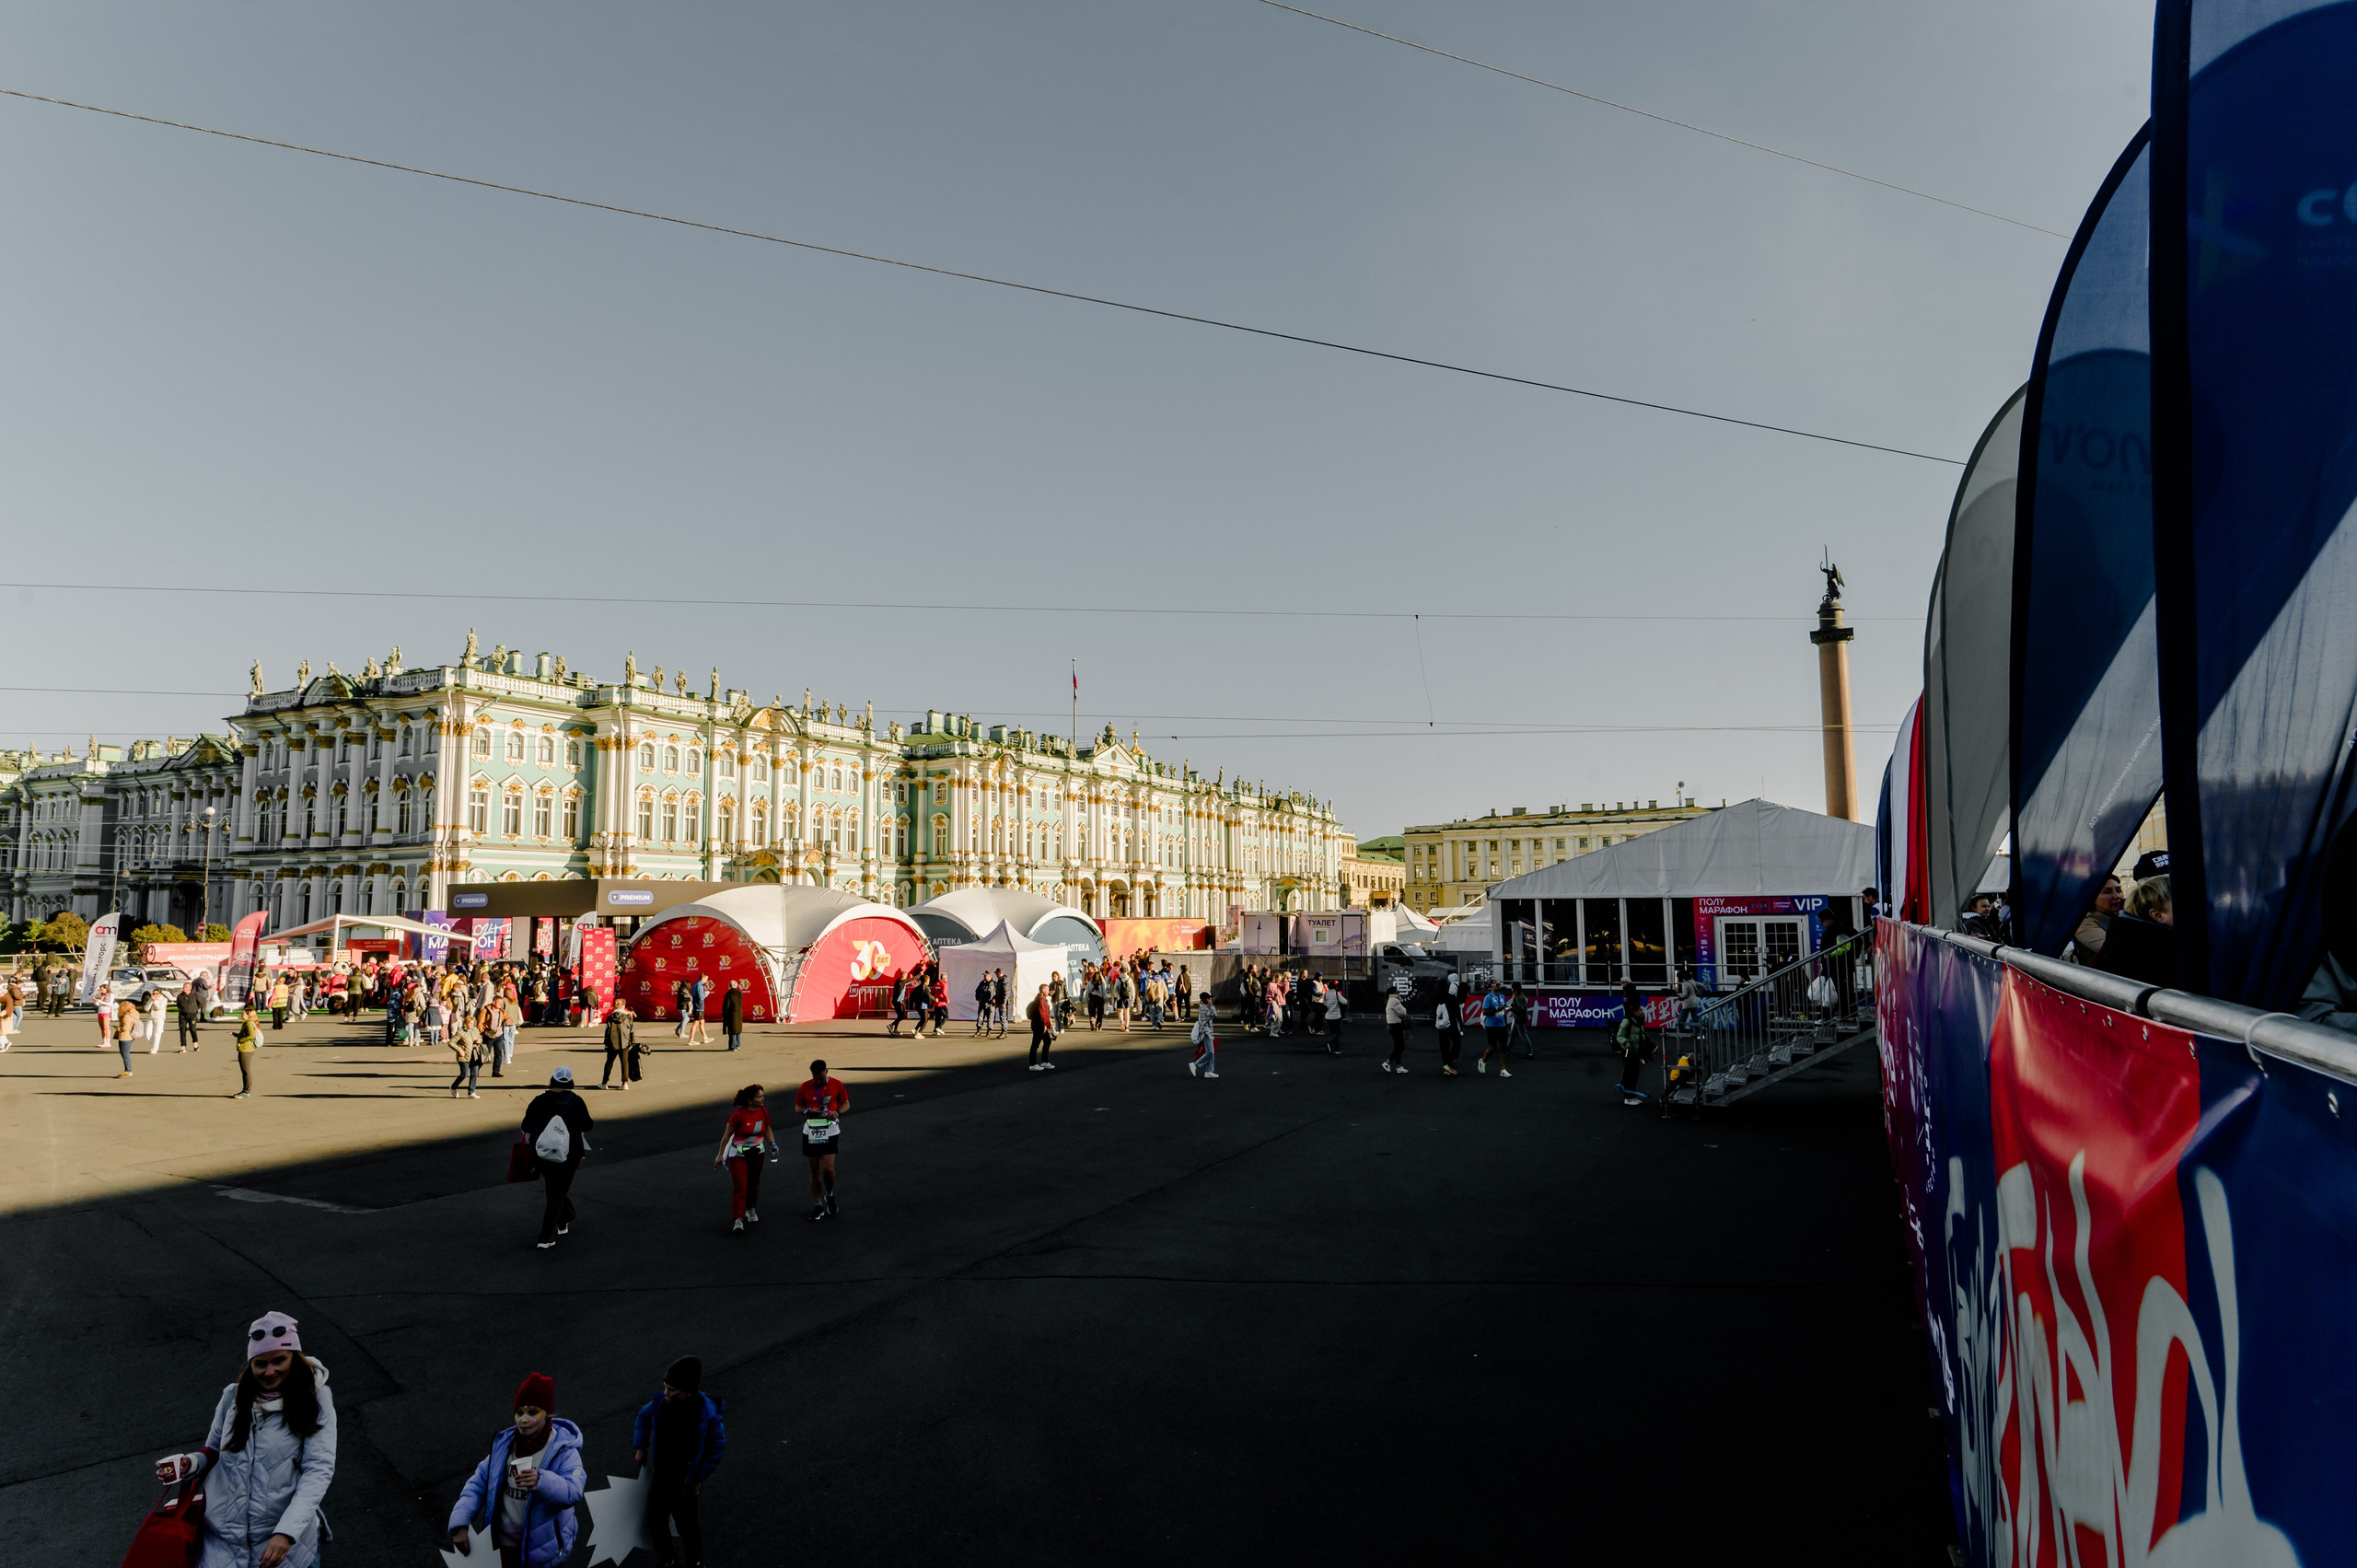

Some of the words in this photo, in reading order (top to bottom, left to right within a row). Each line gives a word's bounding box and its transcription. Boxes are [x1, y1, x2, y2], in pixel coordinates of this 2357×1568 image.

[1699, 898, 1725, 906] ПОЛУ
[1794, 898, 1823, 911] VIP
[1699, 906, 1747, 914] МАРАФОН
[95, 925, 117, 935] am
[932, 937, 962, 946] АПТЕКА
[851, 940, 886, 981] 30
[1549, 997, 1582, 1008] ПОЛУ
[1549, 1008, 1611, 1019] МАРАФОН
